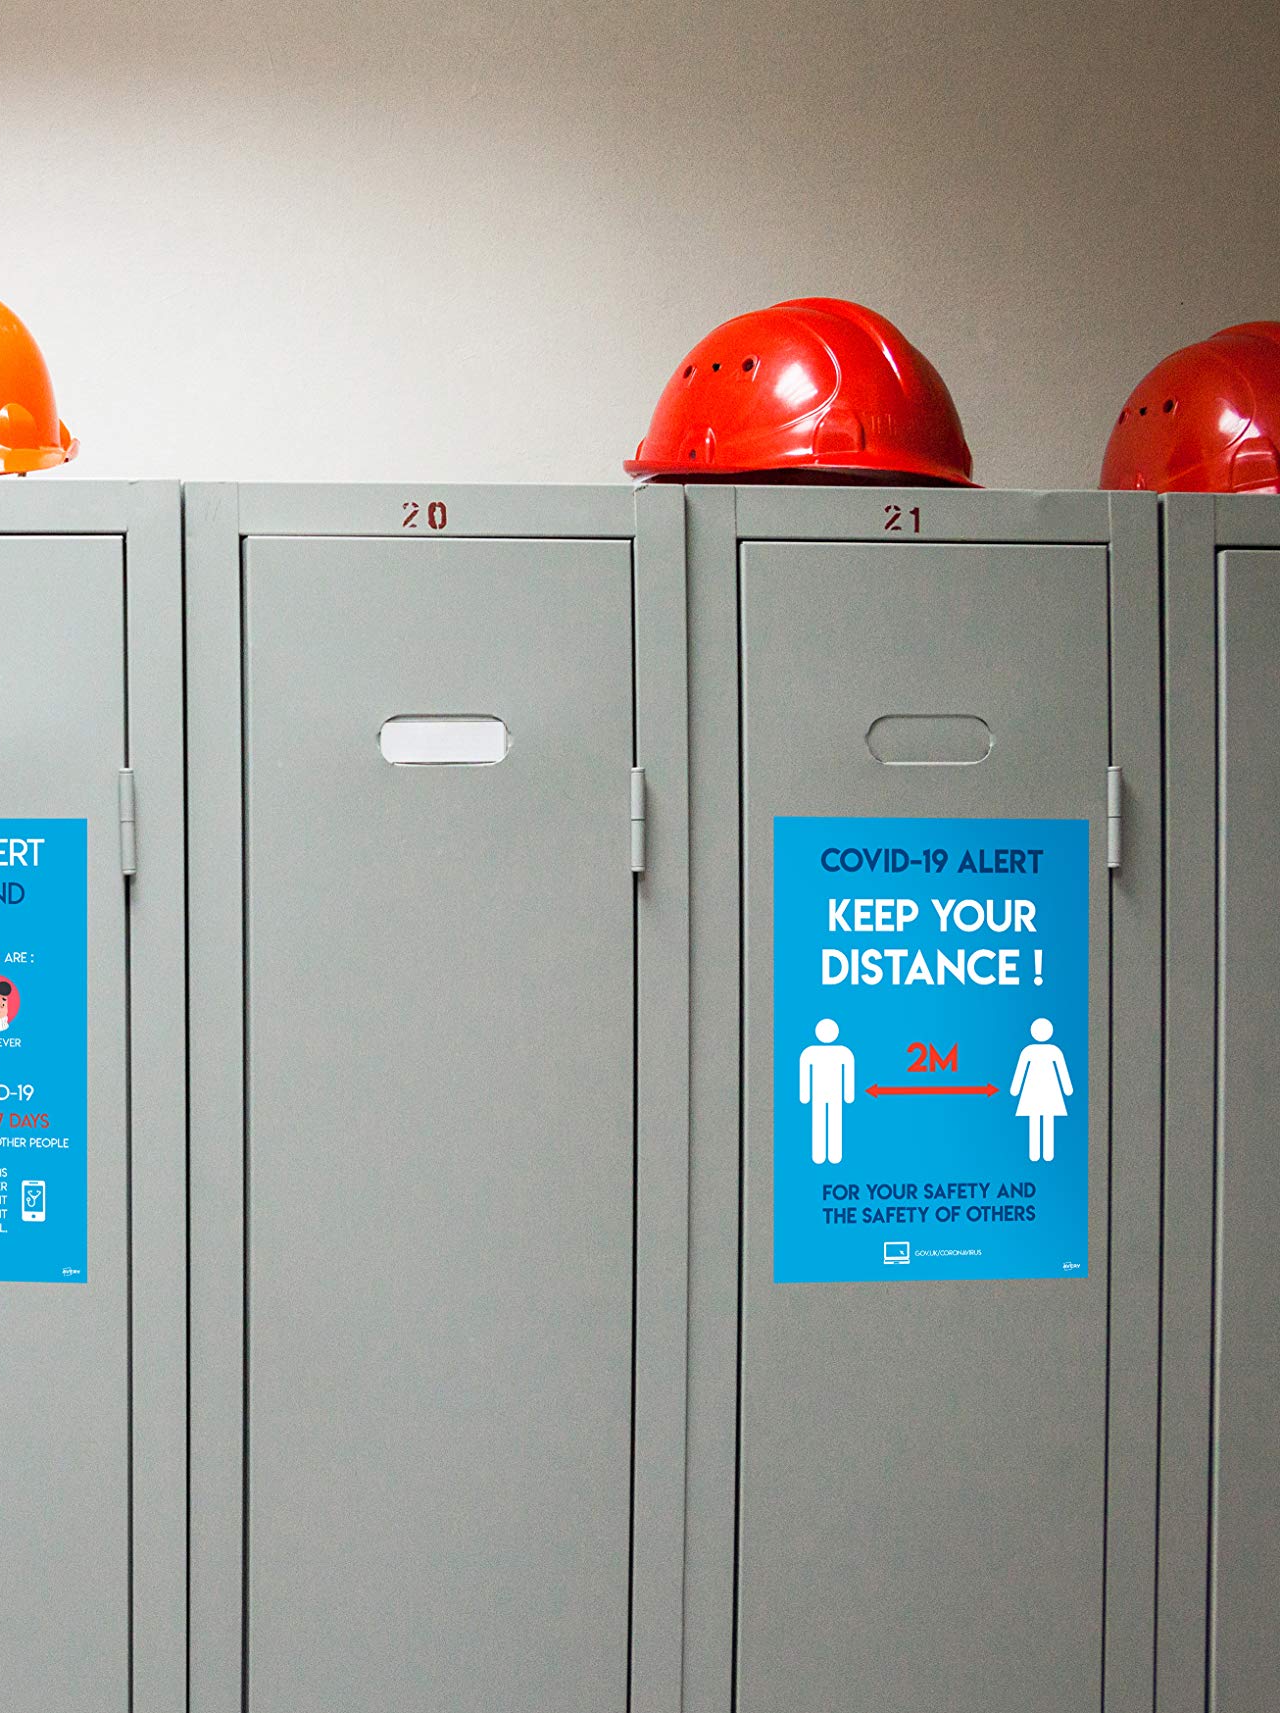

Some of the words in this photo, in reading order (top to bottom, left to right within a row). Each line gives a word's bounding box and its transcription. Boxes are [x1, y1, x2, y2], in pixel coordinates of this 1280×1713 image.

[403, 501, 447, 530] 20
[884, 505, 920, 533] 21
[821, 848, 948, 873] COVID-19
[957, 849, 1044, 874] ALERT
[829, 898, 919, 932] KEEP
[931, 899, 1037, 932] YOUR
[4, 952, 27, 963] ARE
[822, 948, 1020, 985] DISTANCE
[907, 1042, 958, 1072] 2M
[9, 1113, 50, 1129] DAYS
[29, 1137, 69, 1149] PEOPLE
[823, 1184, 860, 1201] FOR
[866, 1183, 918, 1200] YOUR
[924, 1182, 990, 1199] SAFETY
[996, 1182, 1036, 1199] AND
[822, 1207, 857, 1224] THE
[862, 1206, 929, 1223] SAFETY
[935, 1206, 961, 1222] OF
[966, 1205, 1036, 1222] OTHERS
